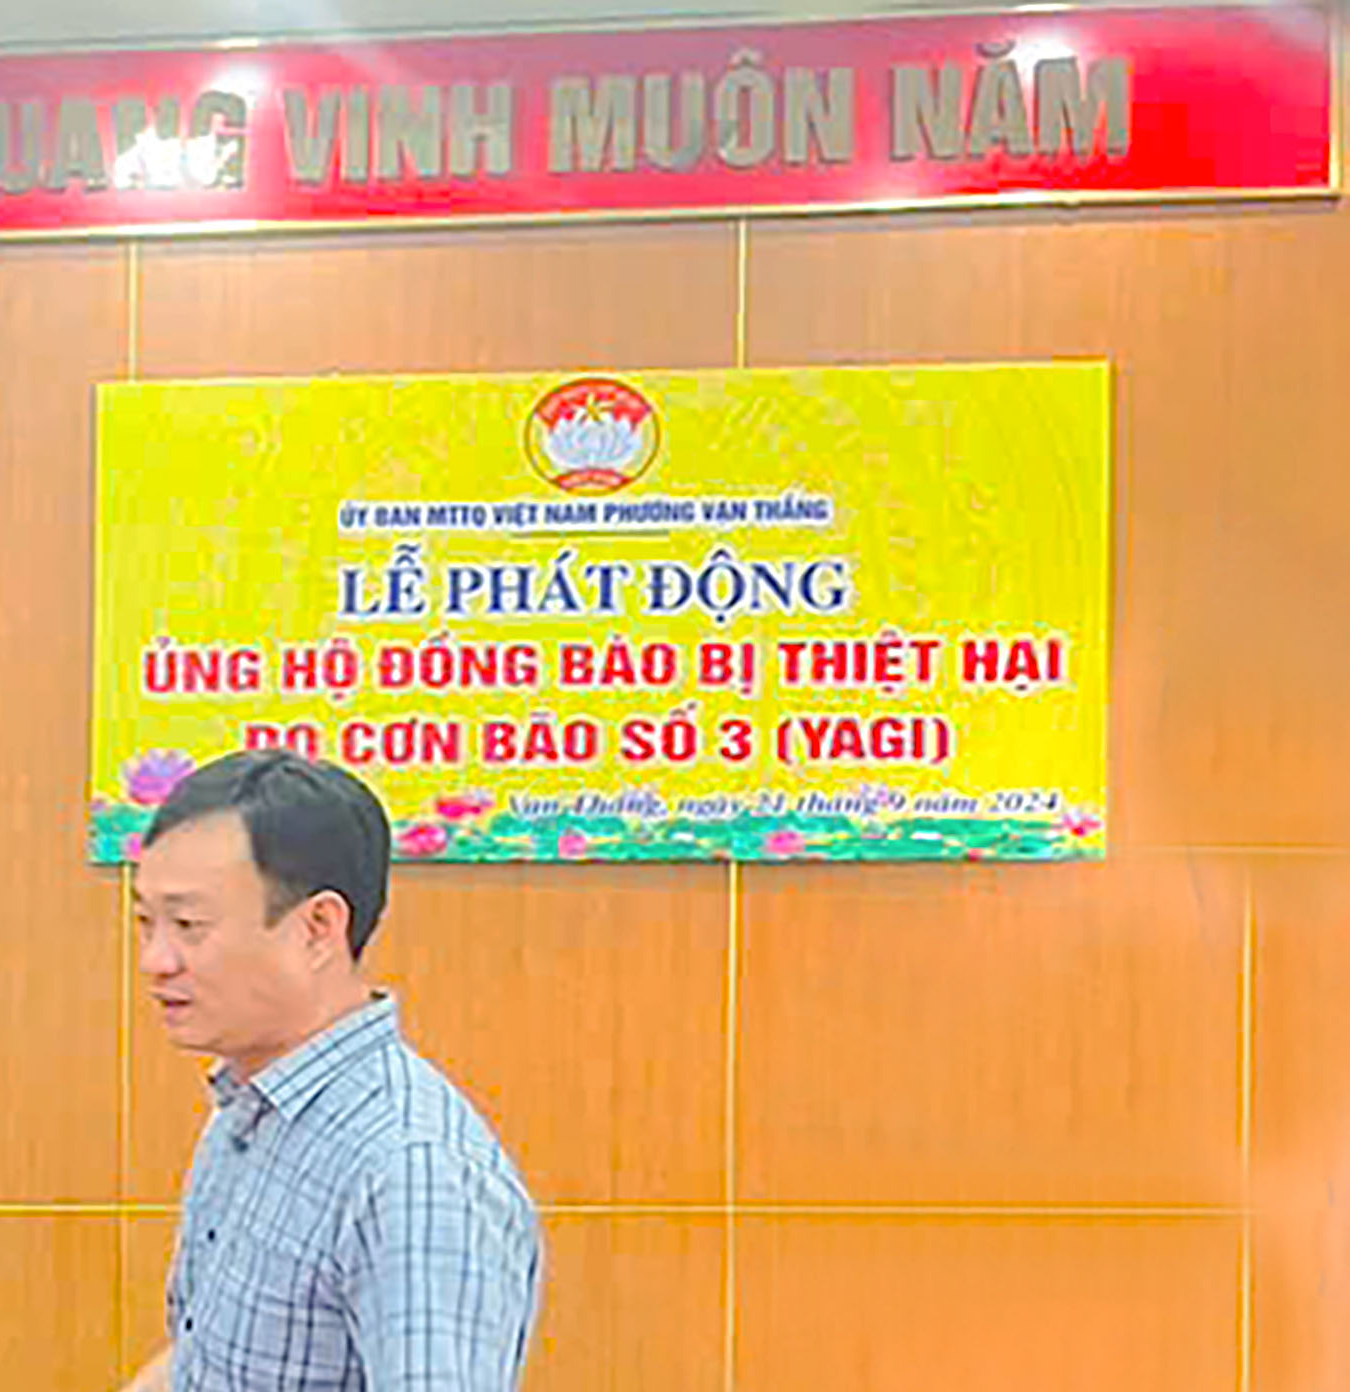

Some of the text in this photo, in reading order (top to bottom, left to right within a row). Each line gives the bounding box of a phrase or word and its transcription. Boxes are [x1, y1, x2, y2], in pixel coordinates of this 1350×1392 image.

[280, 82, 513, 186] VINH
[547, 46, 854, 174] MUÔN
[889, 41, 1132, 163] NĂM
[374, 505, 422, 527] BAN
[491, 502, 538, 530] VIỆT
[543, 502, 598, 525] NAM
[339, 542, 848, 623] LỄ PHÁT ĐỘNG
[143, 635, 262, 694] ỦNG
[281, 637, 359, 700] HỘ
[560, 633, 677, 687] BÀO
[700, 641, 755, 694] BỊ
[778, 629, 941, 694] THIỆT
[962, 639, 1061, 692] HẠI
[341, 716, 460, 763] CƠN
[481, 712, 600, 762] BÃO
[621, 702, 697, 763] SỐ
[719, 718, 752, 762] 3
[776, 717, 950, 763] (YAGI)
[988, 791, 1060, 813] 2024
